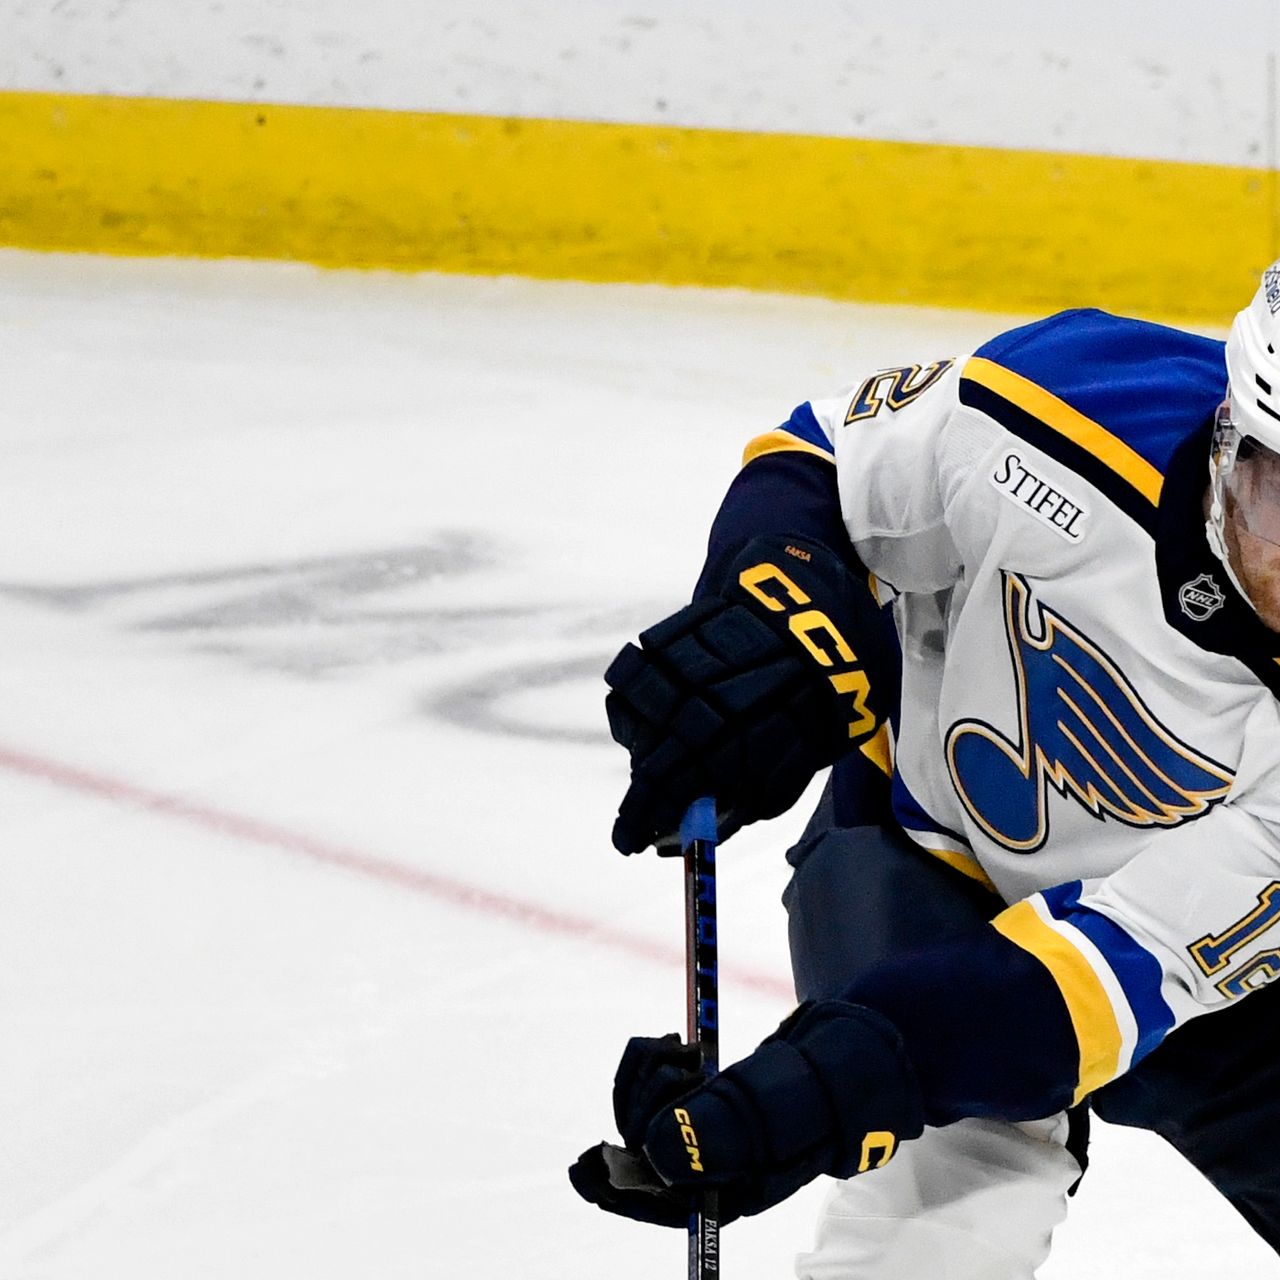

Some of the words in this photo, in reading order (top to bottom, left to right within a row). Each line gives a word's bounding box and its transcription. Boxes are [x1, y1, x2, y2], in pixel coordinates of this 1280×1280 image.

[994, 454, 1085, 538] STIFEL
[1185, 591, 1214, 606] NHL
[739, 563, 876, 738] CCM
[674, 1108, 704, 1172] CCM
[704, 1217, 718, 1254] FAKSA
[704, 1258, 718, 1271] 12
